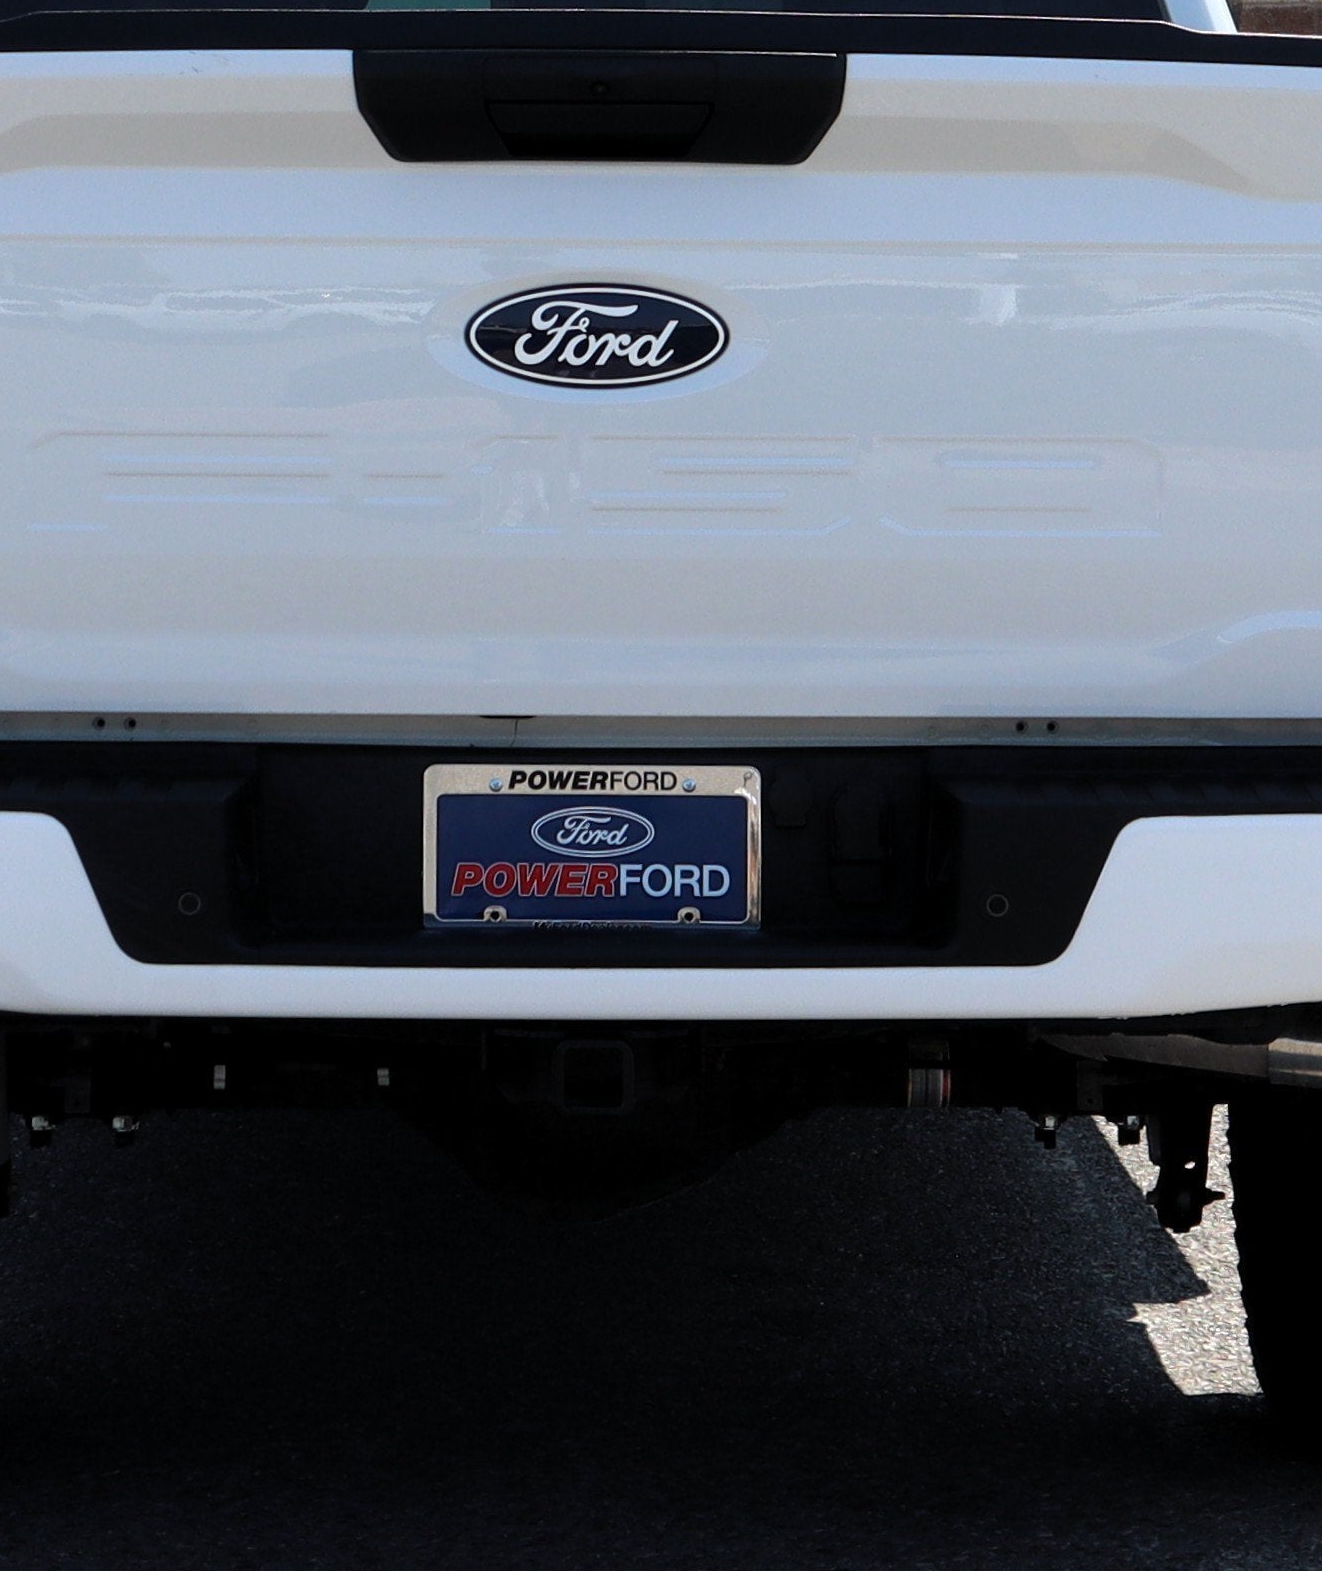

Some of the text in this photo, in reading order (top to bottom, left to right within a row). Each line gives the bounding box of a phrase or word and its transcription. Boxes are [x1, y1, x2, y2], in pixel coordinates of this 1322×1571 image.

[514, 300, 680, 368] Ford
[508, 770, 678, 791] POWERFORD
[556, 815, 630, 847] Ford
[451, 862, 731, 898] POWERFORD
